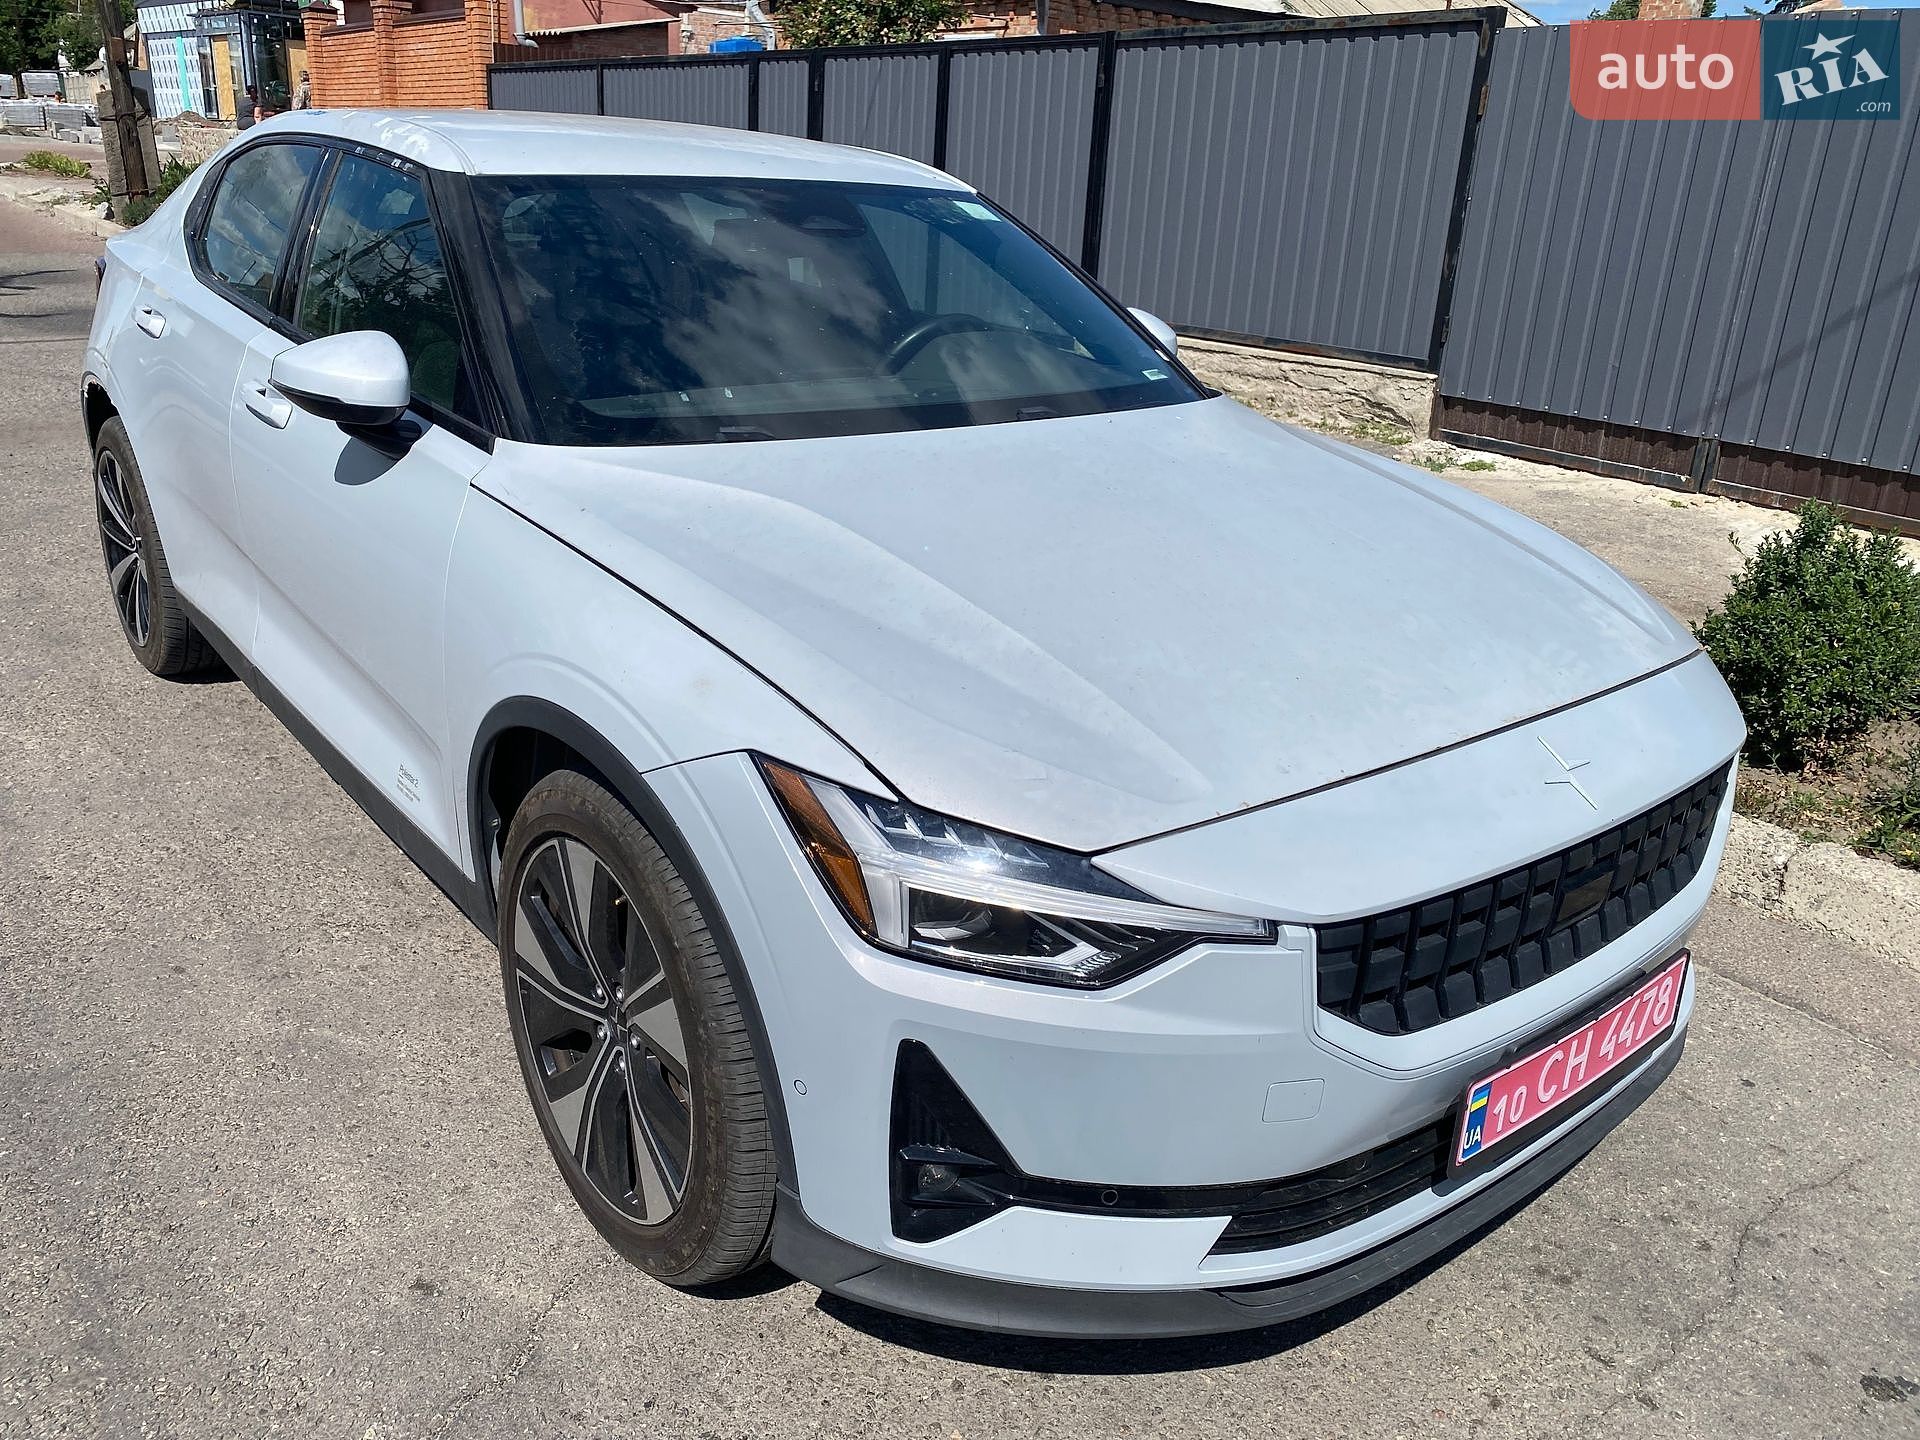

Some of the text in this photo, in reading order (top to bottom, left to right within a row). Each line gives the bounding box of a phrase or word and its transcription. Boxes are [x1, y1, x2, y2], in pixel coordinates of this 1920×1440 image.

[1493, 976, 1673, 1133] 10 CH 4478
[1463, 1125, 1482, 1150] UA
